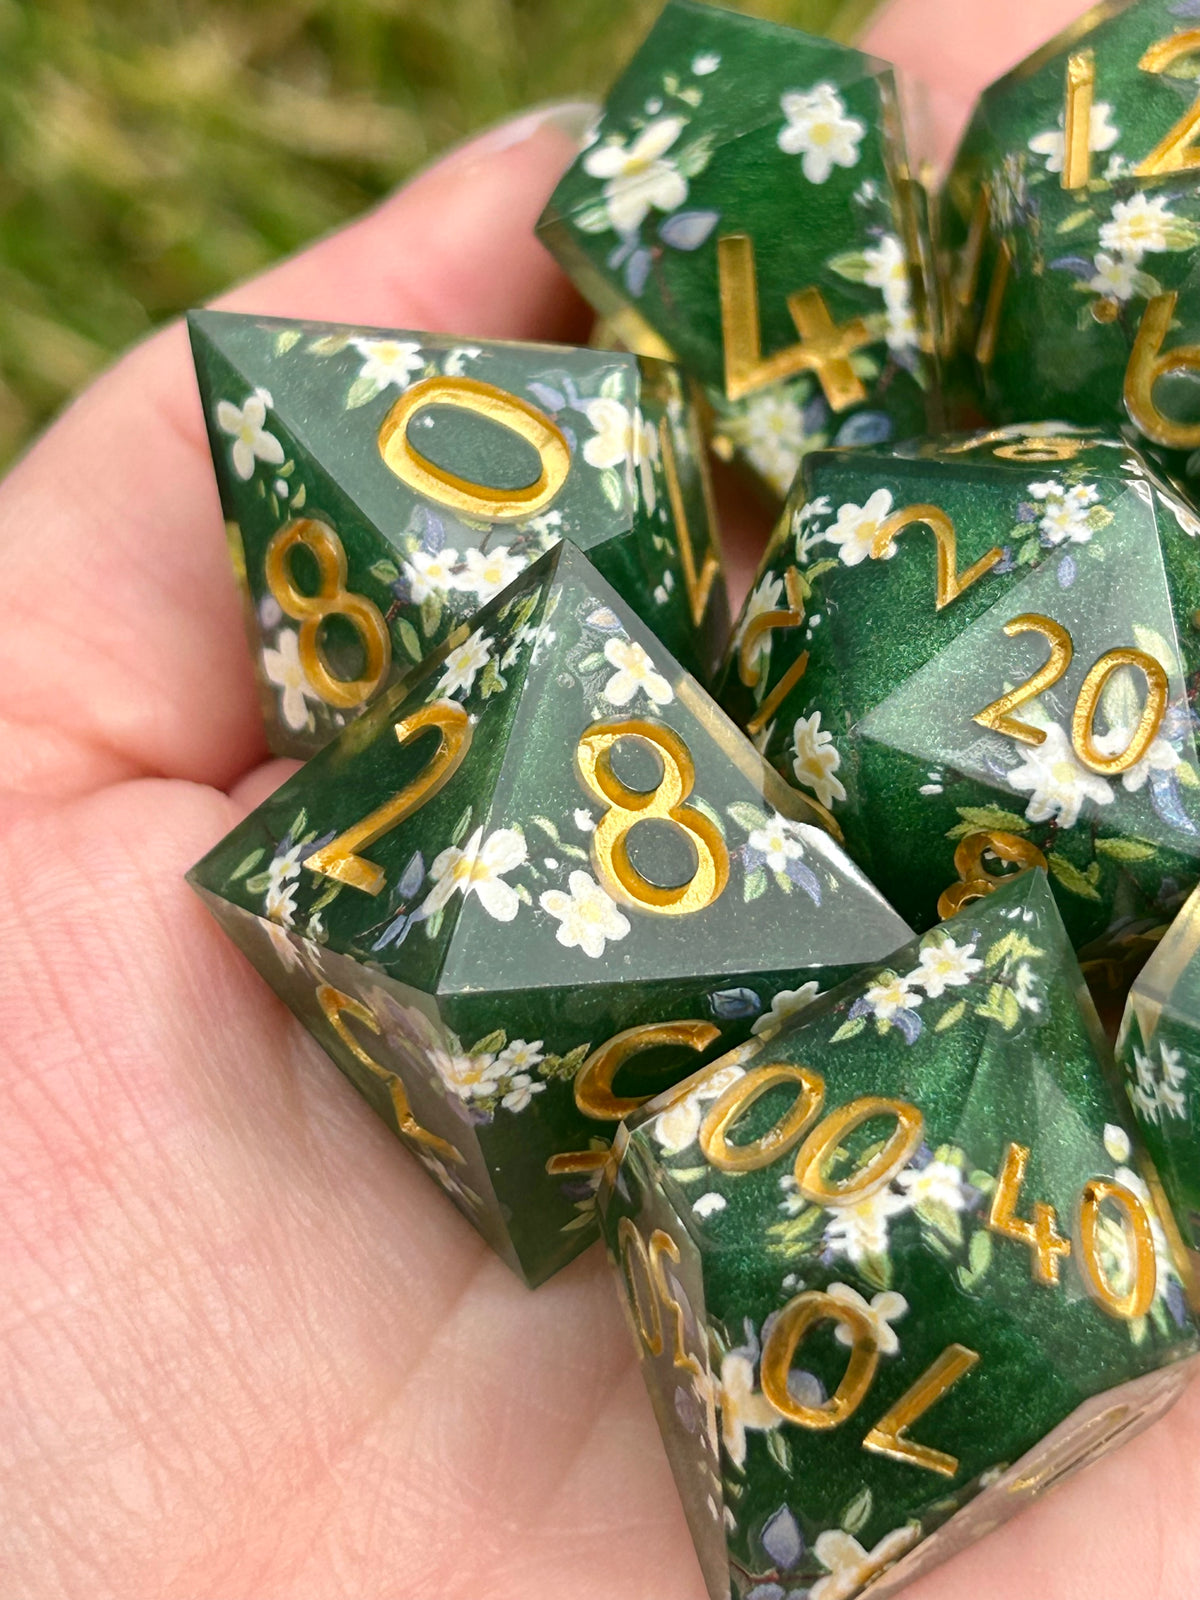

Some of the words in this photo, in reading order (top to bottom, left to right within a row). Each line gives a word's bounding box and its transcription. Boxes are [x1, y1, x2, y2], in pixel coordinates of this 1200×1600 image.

[718, 233, 871, 412] 4
[376, 375, 571, 524] 0
[265, 518, 392, 708] 8
[870, 503, 1003, 611] 2
[972, 612, 1169, 776] 20
[303, 698, 473, 896] 2
[573, 714, 730, 916] 8
[700, 1063, 925, 1206] 00
[988, 1142, 1157, 1319] 40
